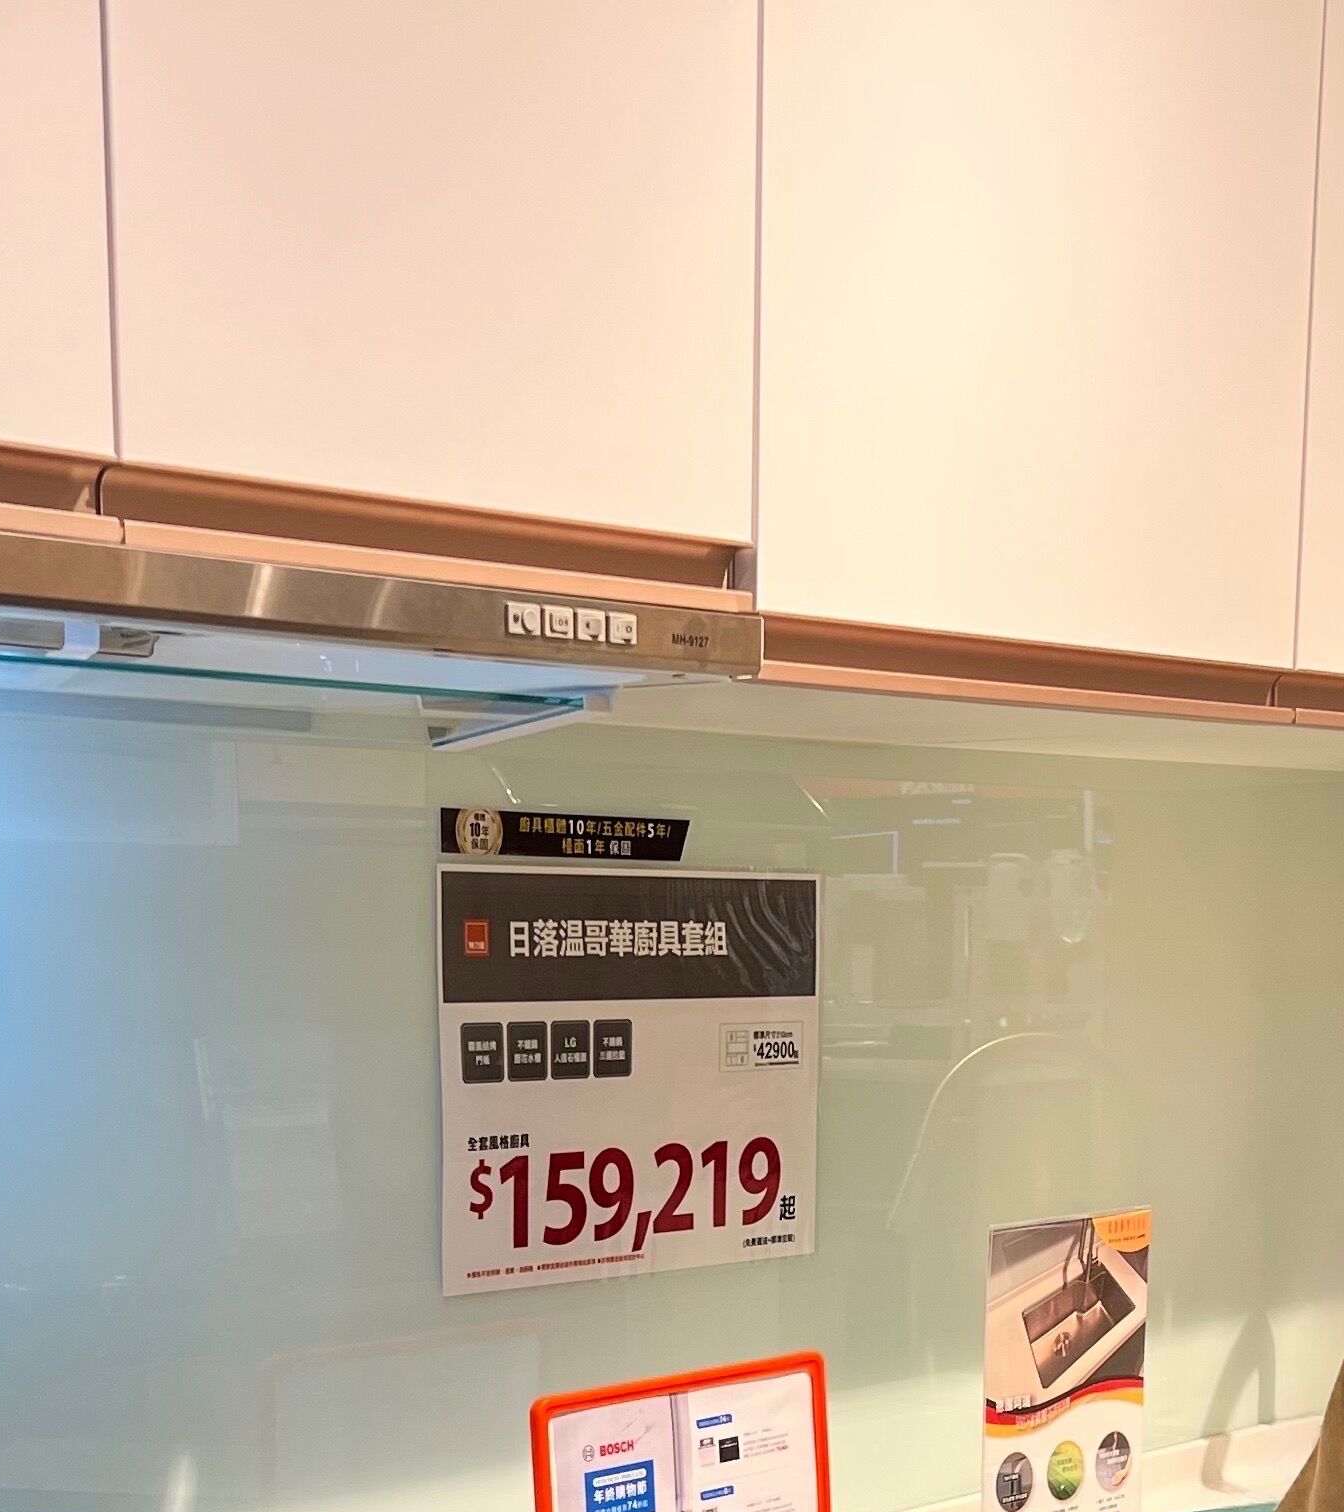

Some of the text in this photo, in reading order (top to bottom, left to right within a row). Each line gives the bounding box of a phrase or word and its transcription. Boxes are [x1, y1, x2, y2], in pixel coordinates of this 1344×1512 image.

[564, 1036, 577, 1048] LG
[467, 1133, 530, 1152] 全套風格廚具
[599, 1439, 634, 1457] BOSCH
